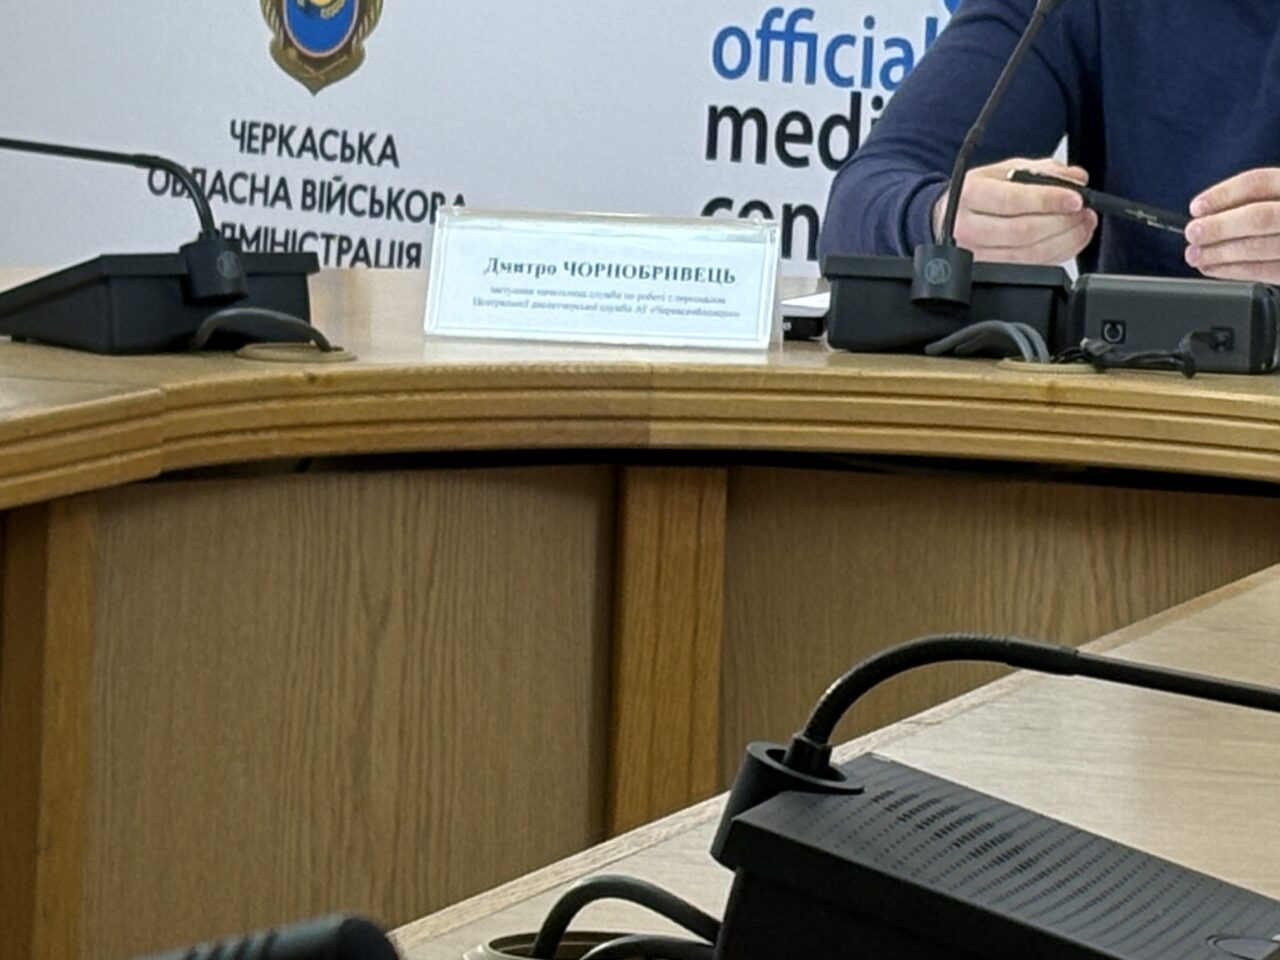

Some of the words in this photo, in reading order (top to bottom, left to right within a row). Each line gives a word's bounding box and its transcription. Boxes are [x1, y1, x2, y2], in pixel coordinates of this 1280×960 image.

[230, 119, 400, 168] ЧЕРКАСЬКА
[705, 91, 884, 171] med
[221, 222, 423, 270] МІНІСТРАЦІЯ
[484, 257, 557, 280] Дмитро
[564, 261, 737, 285] ЧОРНОБРИВЕЦЬ
